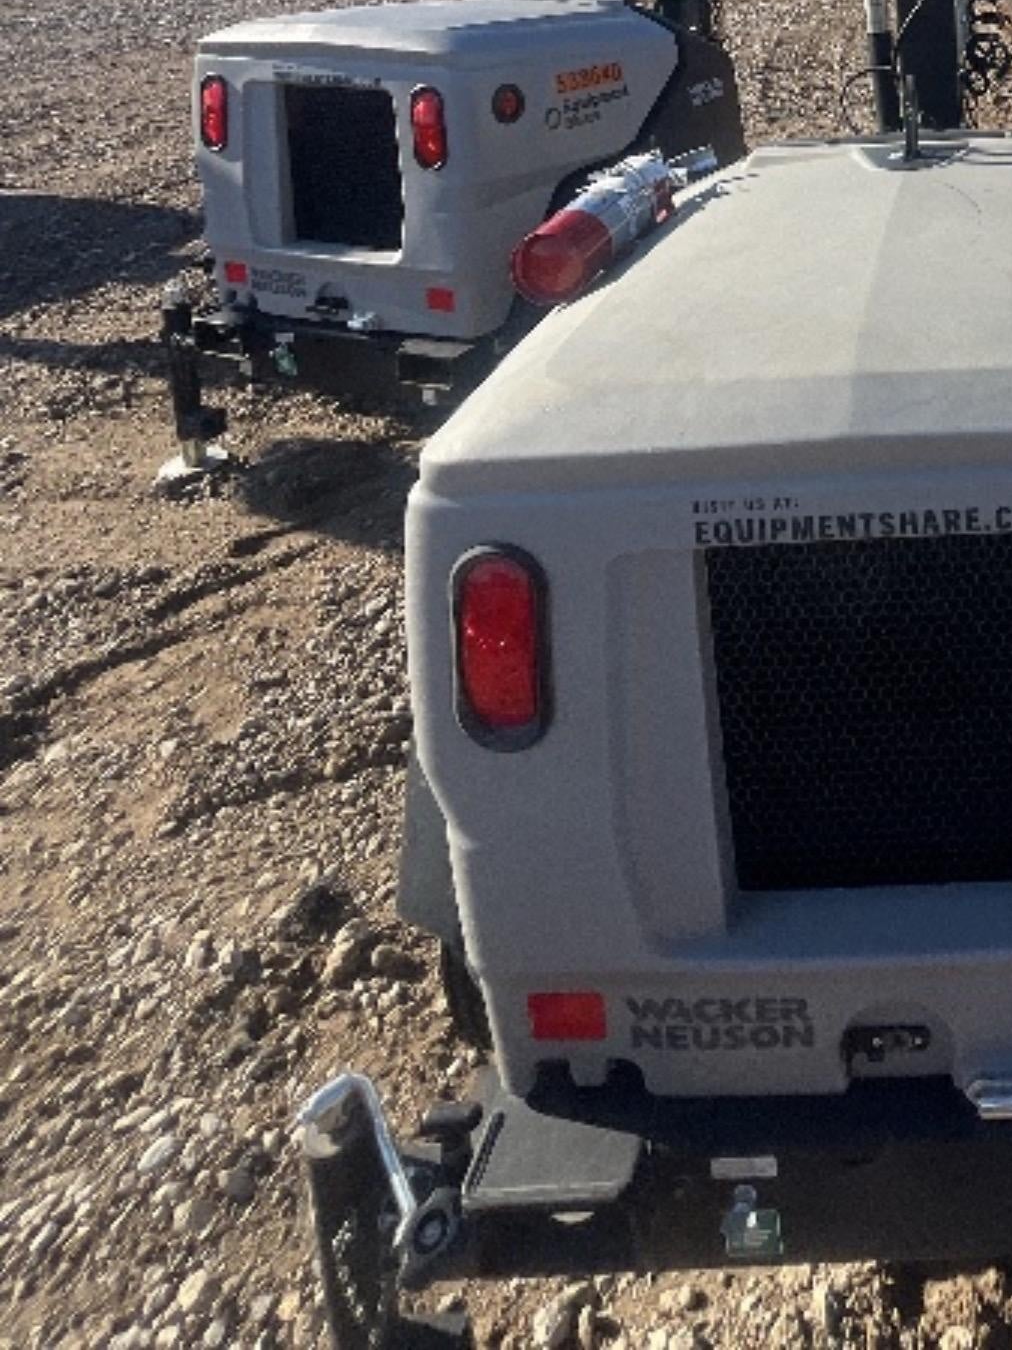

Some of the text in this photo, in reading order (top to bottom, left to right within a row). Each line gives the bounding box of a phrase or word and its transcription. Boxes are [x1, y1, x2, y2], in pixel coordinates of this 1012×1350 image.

[743, 498, 766, 511] US
[626, 998, 808, 1023] WACKER
[630, 1025, 815, 1050] NEUSON
